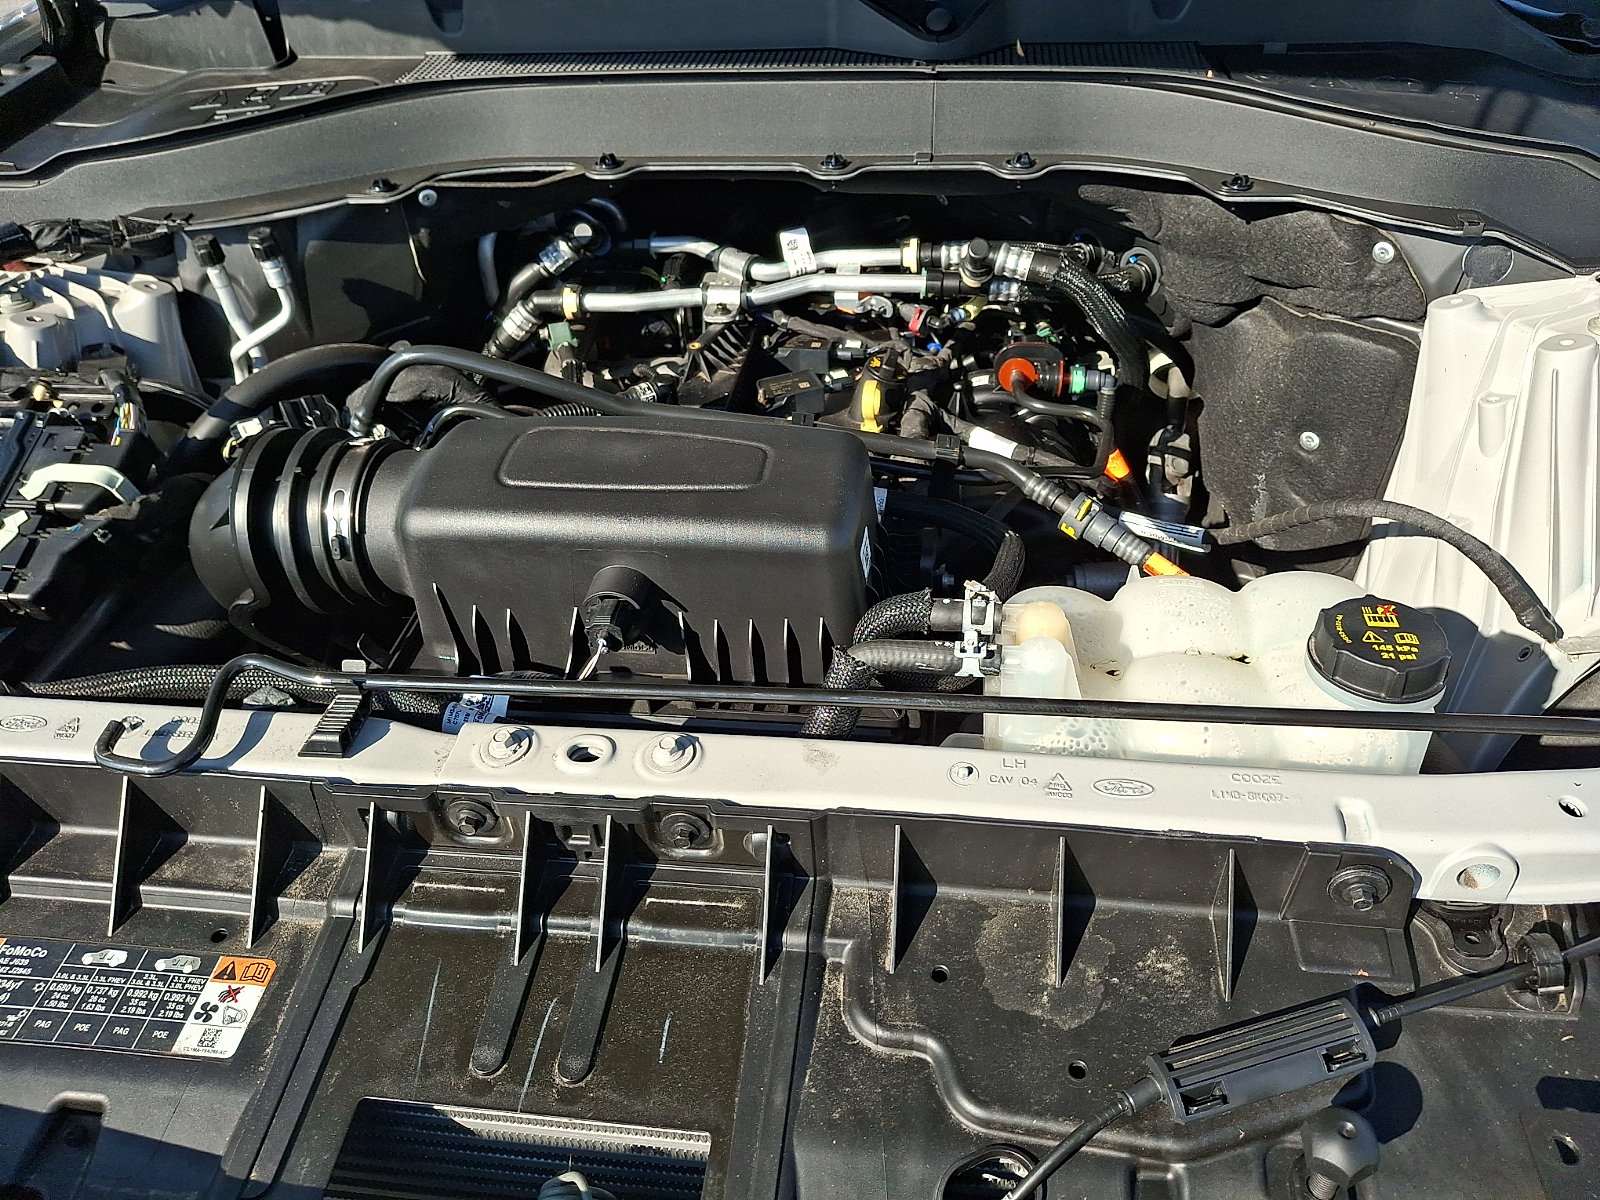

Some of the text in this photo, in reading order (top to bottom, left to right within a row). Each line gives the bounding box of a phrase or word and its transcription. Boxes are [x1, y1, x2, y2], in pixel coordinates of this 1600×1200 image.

[1003, 758, 1026, 768] LH
[989, 775, 1038, 786] CAV 04
[0, 945, 48, 958] FoMoCo
[70, 984, 83, 995] kg
[86, 986, 120, 998] 0.737 kg
[126, 989, 160, 1001] 0.992 kg
[163, 993, 197, 1005] 0.992 kg
[94, 1003, 106, 1011] lbs
[129, 998, 139, 1006] 35
[166, 1002, 176, 1010] 35
[120, 1006, 146, 1015] 2.19 lbs
[158, 1010, 184, 1019] 2.19 lbs
[33, 1019, 52, 1029] PAG
[73, 1023, 92, 1032] POE
[112, 1026, 130, 1036] PAG
[151, 1030, 170, 1039] POE
